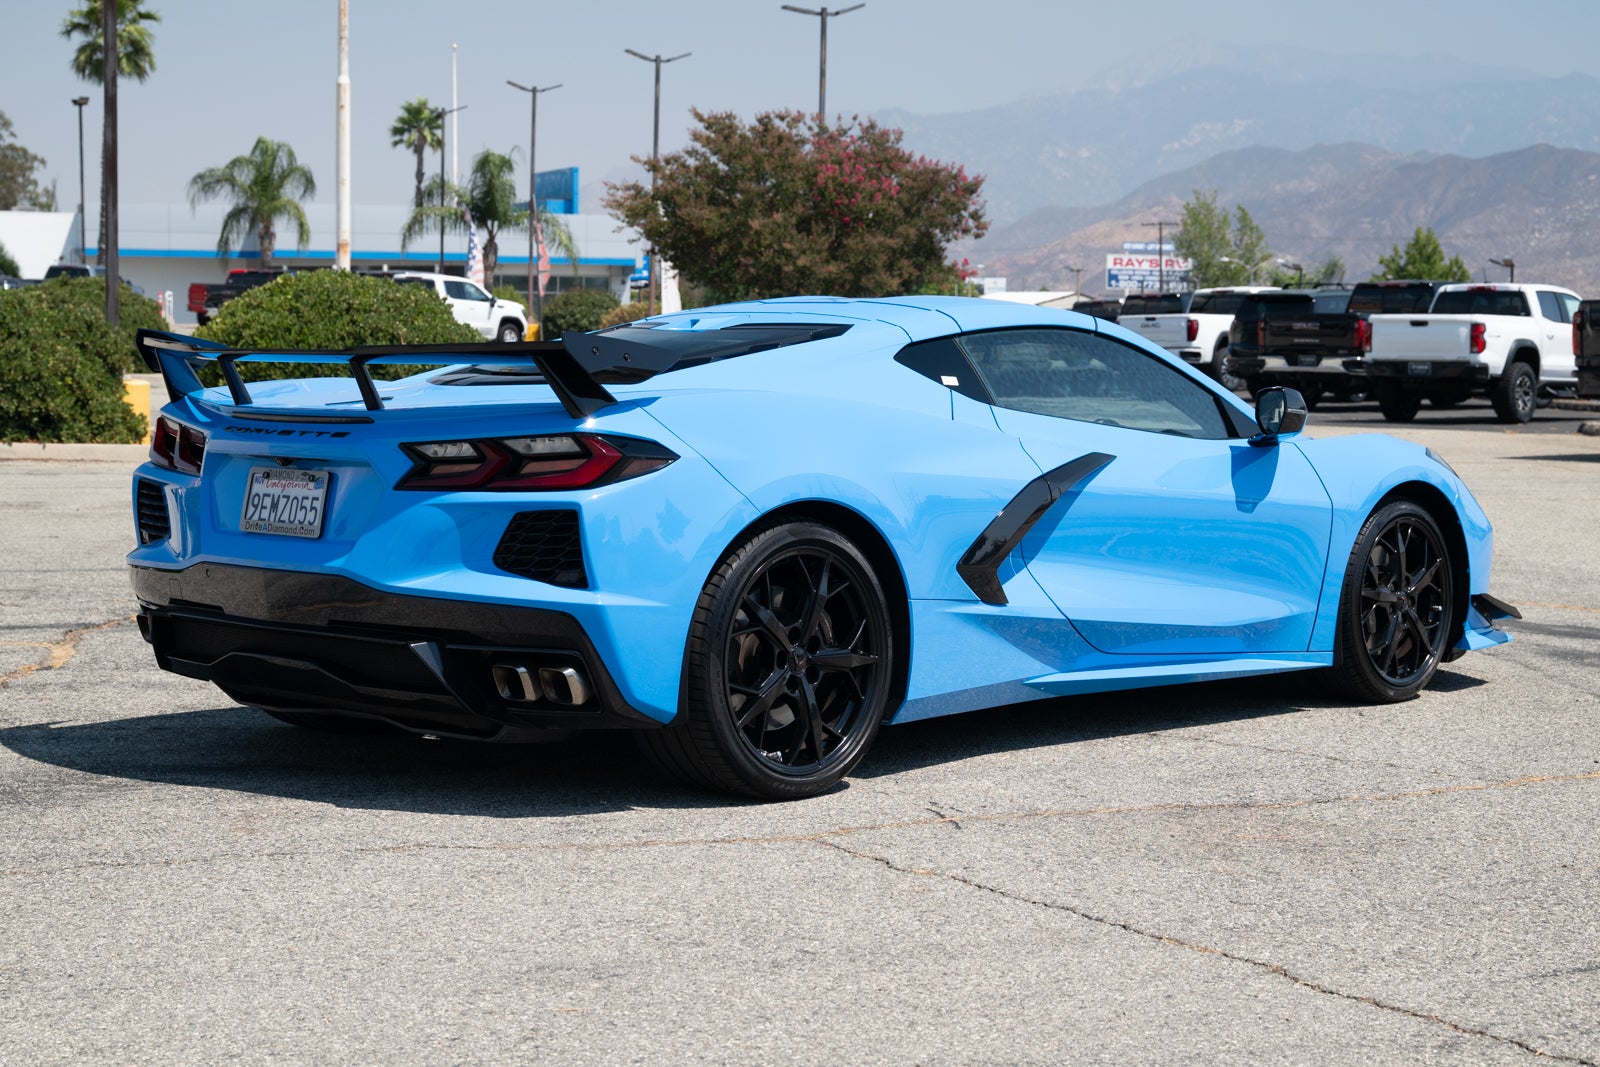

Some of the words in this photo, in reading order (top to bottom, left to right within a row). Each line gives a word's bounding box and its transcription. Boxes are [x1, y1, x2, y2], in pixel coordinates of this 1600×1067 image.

[1113, 257, 1160, 269] RAY'S
[224, 426, 351, 438] CORVETTE
[265, 479, 313, 493] California
[247, 493, 319, 526] 9EMZ055
